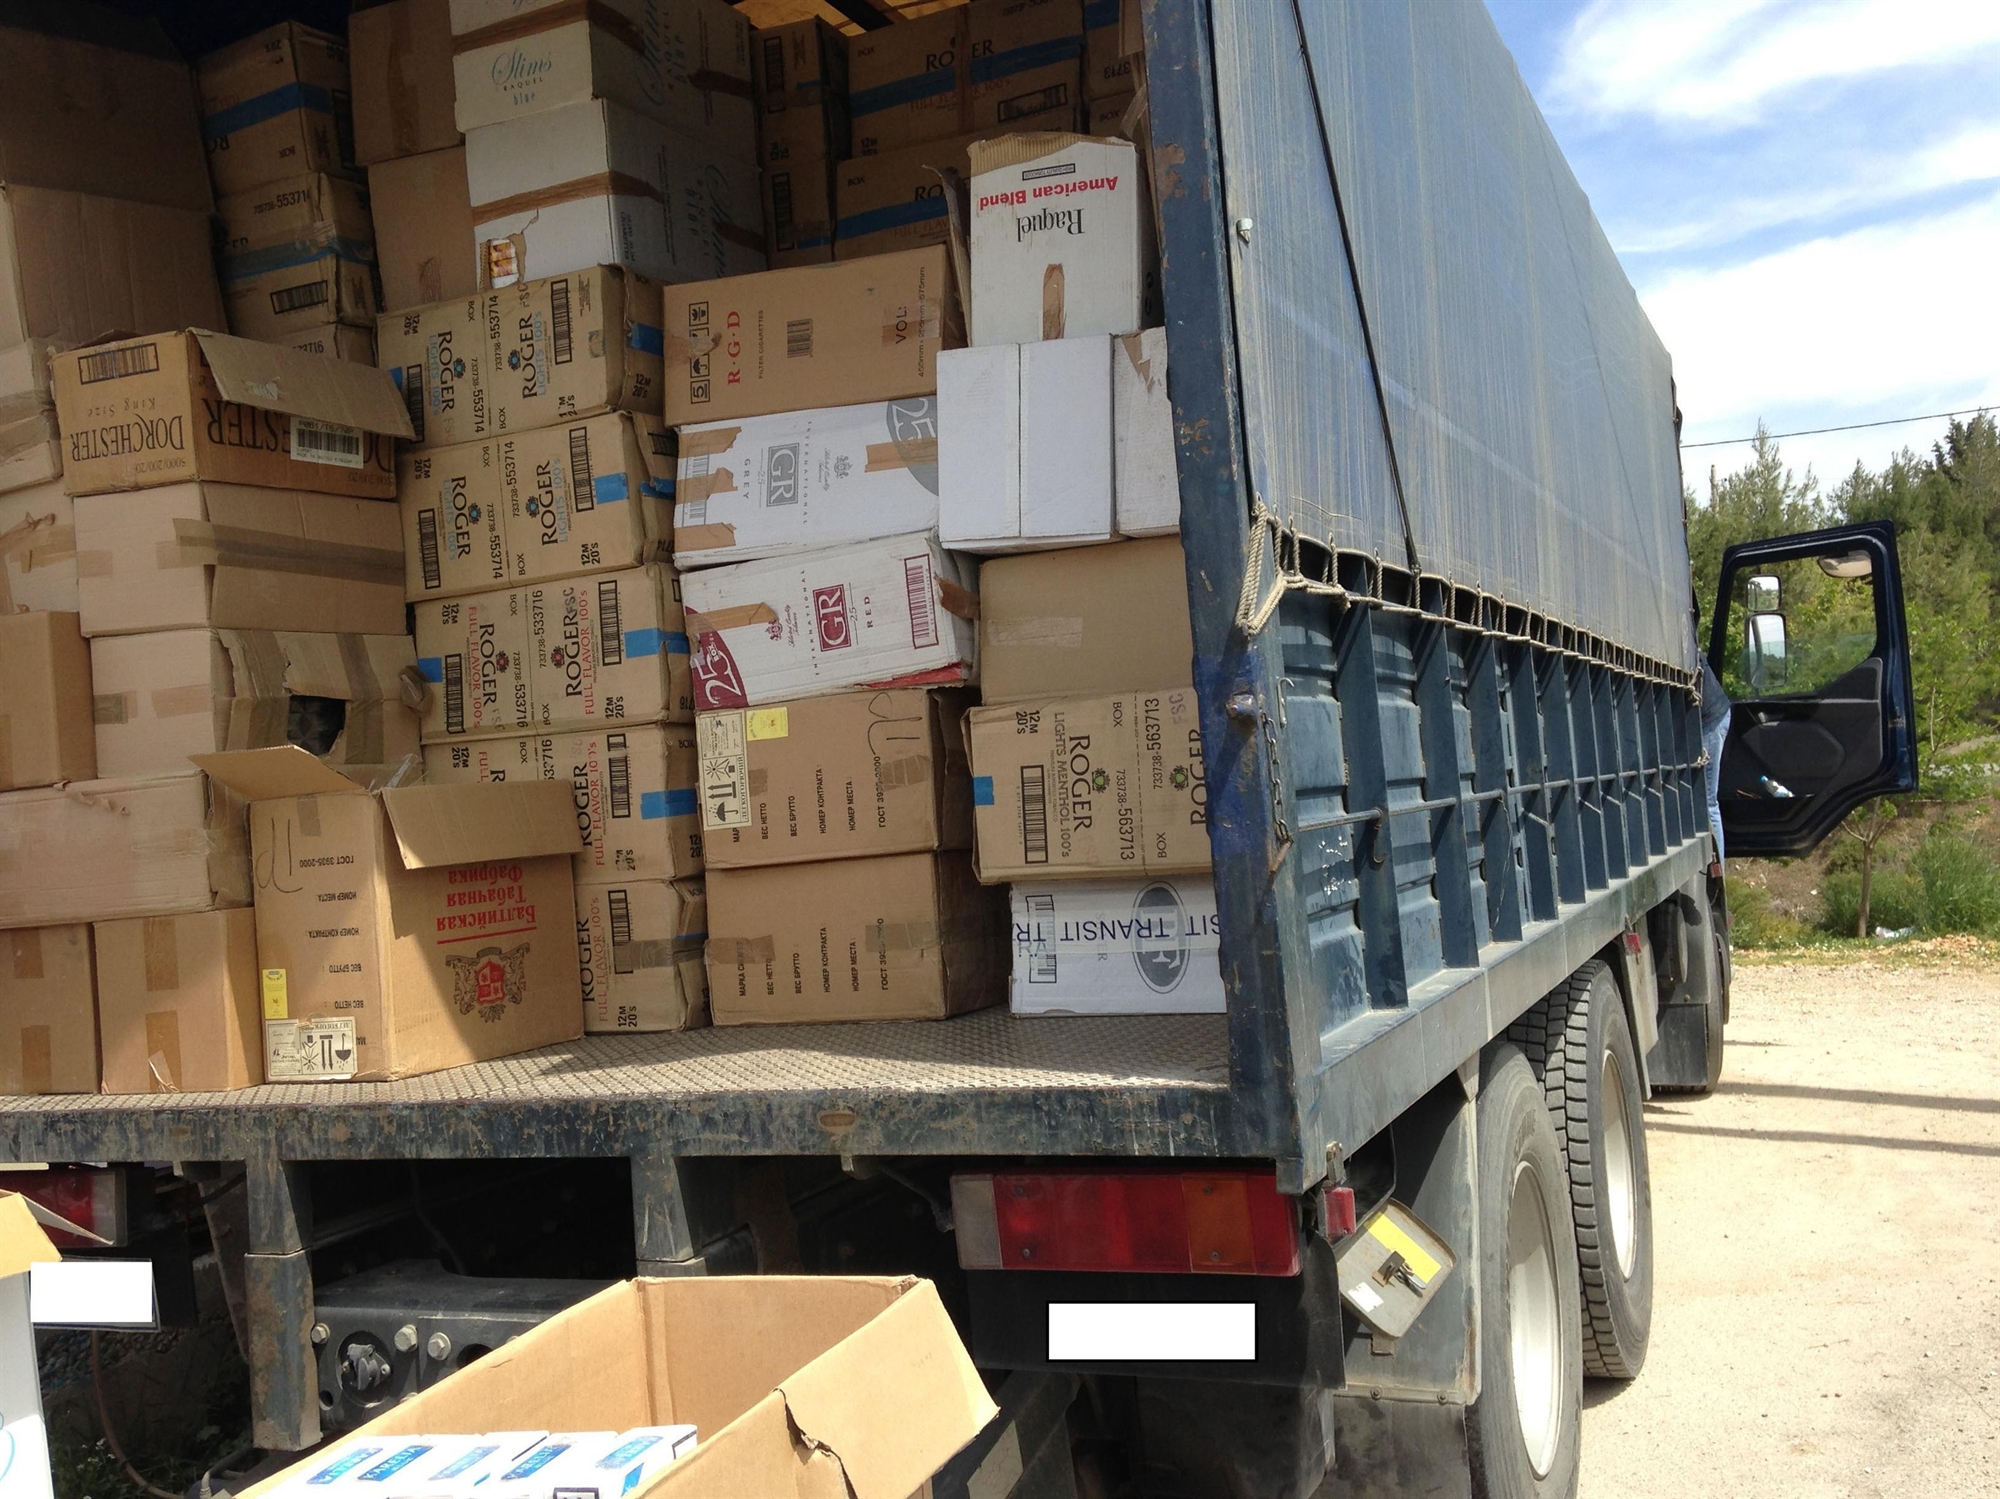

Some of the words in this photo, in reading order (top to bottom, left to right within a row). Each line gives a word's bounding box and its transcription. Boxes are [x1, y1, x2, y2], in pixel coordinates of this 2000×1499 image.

[491, 51, 553, 86] Slims
[503, 77, 544, 92] RAQUEL
[847, 176, 866, 188] BOX
[1032, 176, 1119, 199] American
[978, 189, 1027, 211] Blend
[1015, 207, 1086, 243] Raquel
[404, 315, 412, 336] 20's
[411, 313, 420, 335] 12M
[489, 294, 502, 372] 733738-553714
[532, 310, 544, 343] 100's
[895, 305, 908, 345] VOL:
[518, 312, 538, 400] ROGER
[437, 330, 455, 414] ROGER
[535, 348, 547, 396] LIGHTS
[123, 397, 156, 412] King
[471, 356, 484, 434] 733738-553714
[88, 404, 115, 418] Size
[499, 406, 507, 430] BOX
[71, 414, 186, 462] DORCHESTER
[414, 459, 423, 480] 20's
[422, 457, 431, 479] 12M
[482, 445, 490, 468] BOX
[504, 440, 520, 519] 733738-553714
[552, 458, 564, 490] 100's
[742, 458, 751, 500] GREY
[757, 470, 766, 486] 25
[769, 448, 797, 504] GR
[802, 420, 813, 525] INTERNATIONAL
[443, 479, 454, 525] LIGHTS
[536, 460, 558, 547] ROGER
[451, 475, 471, 560] ROGER
[556, 495, 568, 543] LIGHTS
[448, 526, 457, 561] 100's
[486, 502, 503, 580] 733738-553714
[580, 543, 590, 566] 12M
[590, 541, 600, 565] 20's
[517, 553, 526, 576] BOX
[441, 603, 450, 625] 20's
[450, 602, 459, 624] 12M
[562, 586, 578, 615] FSC
[579, 590, 589, 621] 100's
[864, 595, 873, 629] RED
[468, 606, 478, 637] FULL
[800, 569, 820, 676] INTERNATIONAL
[818, 587, 847, 647] GR
[849, 606, 859, 623] 25
[532, 589, 547, 669] 733738-533716
[479, 622, 497, 708] ROGER
[563, 610, 582, 697] ROGER
[580, 626, 592, 678] FLAVOR
[707, 643, 720, 662] BOX
[470, 641, 482, 691] FLAVOR
[512, 650, 528, 728] 733738-533716
[584, 682, 595, 715] FULL
[473, 697, 483, 729] 100's
[542, 703, 551, 726] BOX
[605, 696, 614, 719] 12M
[614, 696, 624, 719] 20's
[1112, 701, 1123, 728] BOX
[1015, 710, 1027, 735] 20's
[1028, 709, 1041, 734] 12M
[1054, 711, 1067, 757] LIGHTS
[461, 745, 470, 769] 12M
[519, 741, 528, 764] BOX
[1144, 697, 1163, 790] 733738-563713
[452, 746, 461, 769] 20's
[1056, 759, 1071, 826] MENTHOL
[1068, 734, 1093, 833] ROGER
[589, 779, 602, 830] FLAVOR
[760, 802, 768, 826] НЕТТО
[788, 795, 796, 822] БРУТТО
[878, 806, 888, 828] ГОСТ
[1116, 769, 1136, 861] 733738-563713
[790, 822, 798, 837] ВЕС
[818, 806, 827, 834] НОМЕР
[594, 835, 605, 867] FULL
[1060, 827, 1072, 858] 100's
[1156, 831, 1168, 859] BOX
[337, 855, 355, 866] ГОСТ
[447, 864, 523, 886] Фабрика
[337, 891, 357, 902] НОМЕР
[446, 885, 527, 908] Табачная
[436, 904, 536, 932] Балтийская
[590, 897, 602, 928] 100's
[340, 928, 360, 938] НОМЕР
[1060, 917, 1170, 941] TRANSIT
[347, 963, 362, 973] ВЕС
[593, 934, 606, 985] FLAVOR
[765, 957, 774, 980] НЕТТО
[792, 952, 800, 979] БРУТТО
[738, 972, 747, 997] МАРКА
[767, 979, 775, 996] ВЕС
[794, 979, 802, 994] ВЕС
[822, 965, 831, 993] НОМЕР
[851, 965, 860, 992] НОМЕР
[880, 968, 889, 991] ГОСТ
[334, 1001, 350, 1010] НЕТТО
[349, 1000, 364, 1010] ВЕС
[598, 990, 608, 1022] FULL
[618, 1005, 627, 1028] 12M
[627, 1005, 638, 1028] 20's
